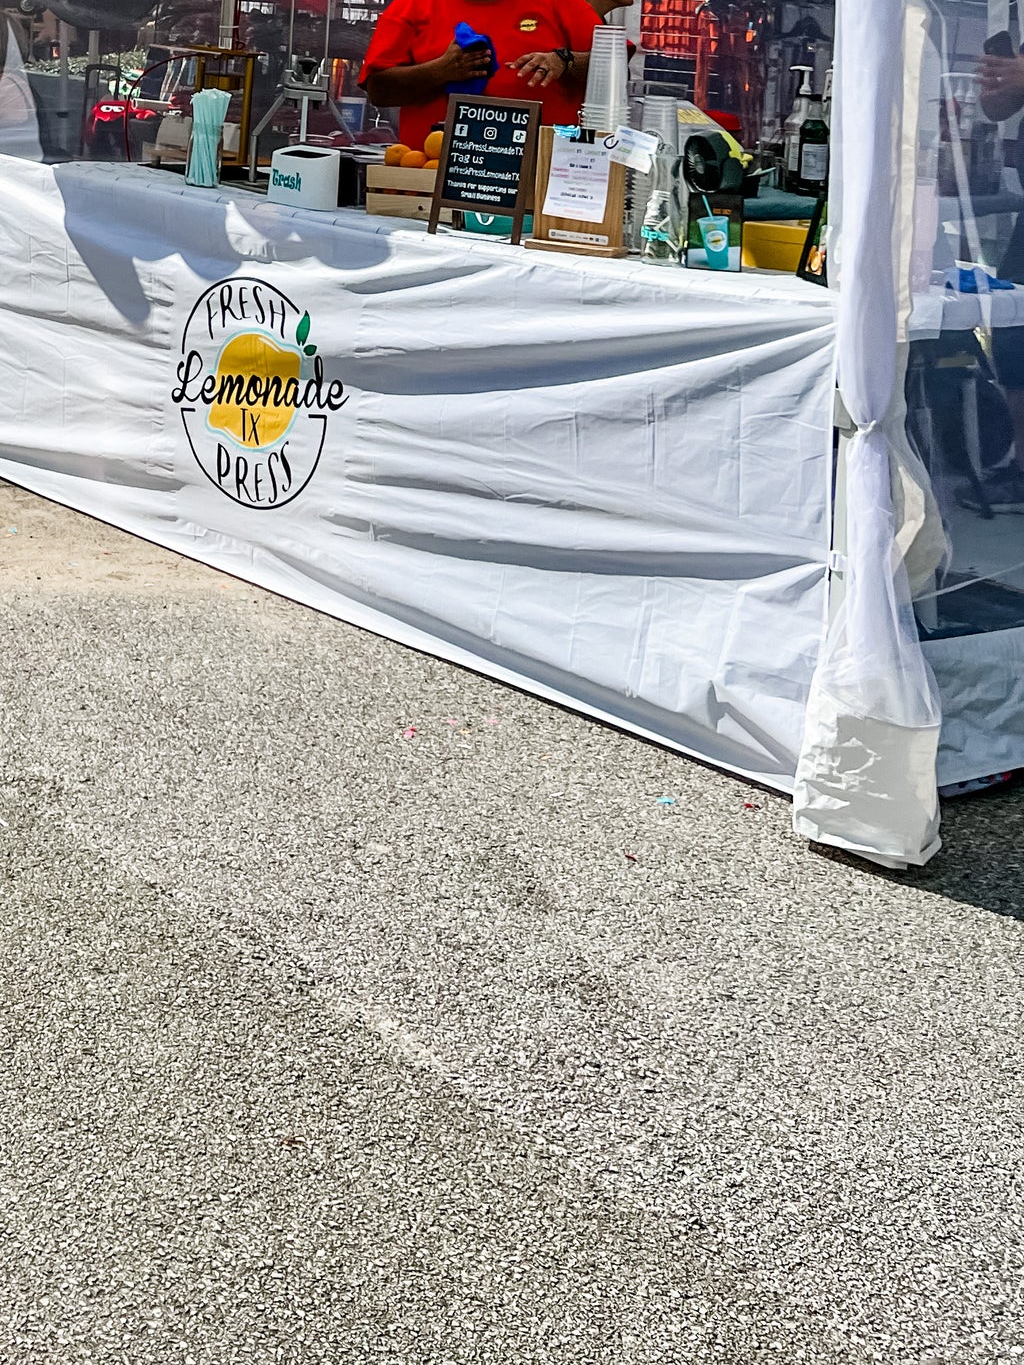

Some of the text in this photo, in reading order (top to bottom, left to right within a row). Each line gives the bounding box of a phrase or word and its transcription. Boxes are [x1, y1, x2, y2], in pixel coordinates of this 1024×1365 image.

[458, 105, 530, 125] Follow us
[450, 152, 485, 165] Tag us
[452, 140, 524, 156] FreshPressLemonadeTX
[447, 179, 467, 189] Thanks
[206, 284, 286, 340] FRESH
[171, 350, 350, 411] Lemonade
[240, 408, 261, 446] TX
[217, 440, 292, 503] PRESS
